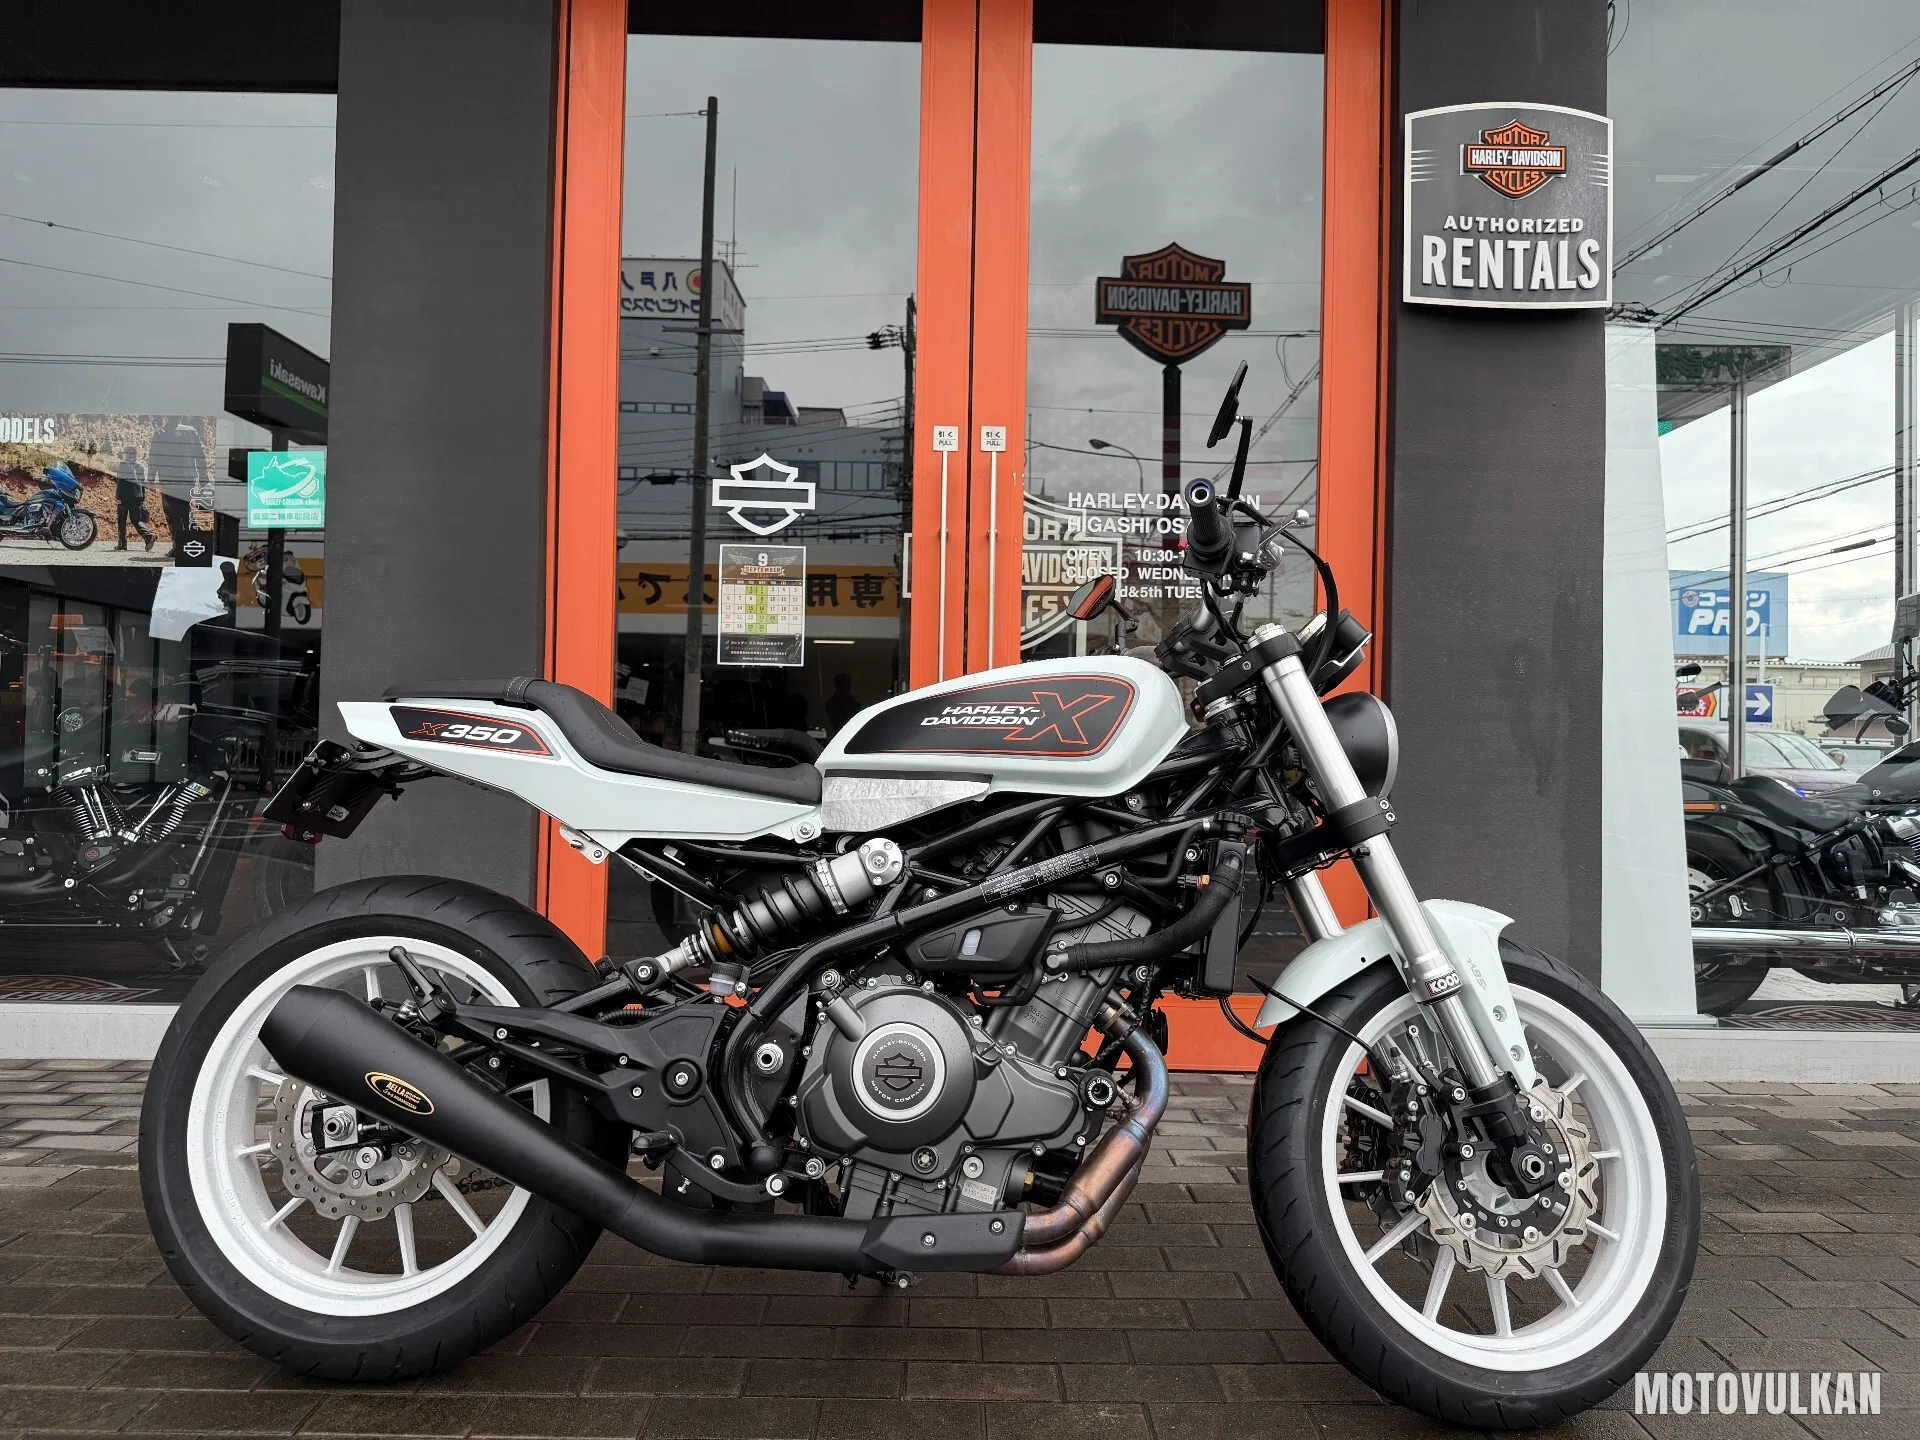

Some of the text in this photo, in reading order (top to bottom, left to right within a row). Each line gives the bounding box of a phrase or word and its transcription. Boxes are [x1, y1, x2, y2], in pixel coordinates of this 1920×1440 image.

[1493, 129, 1540, 145] MOTOR
[1471, 149, 1561, 168] HARLEY-DAVIDSON
[1492, 171, 1541, 191] CYCLES
[1443, 215, 1584, 234] AUTHORIZED
[1421, 235, 1600, 292] RENTALS
[1068, 516, 1150, 534] HIGASHI
[757, 552, 769, 567] 9
[1066, 547, 1108, 560] OPEN
[1066, 566, 1130, 580] CLOSED
[1698, 591, 1766, 608] コーン
[920, 715, 1038, 726] DAVIDSON
[408, 722, 522, 744] X350
[872, 1039, 927, 1062] HARLEY-DAVIDSON
[871, 1080, 926, 1103] MOTOR COMPANY
